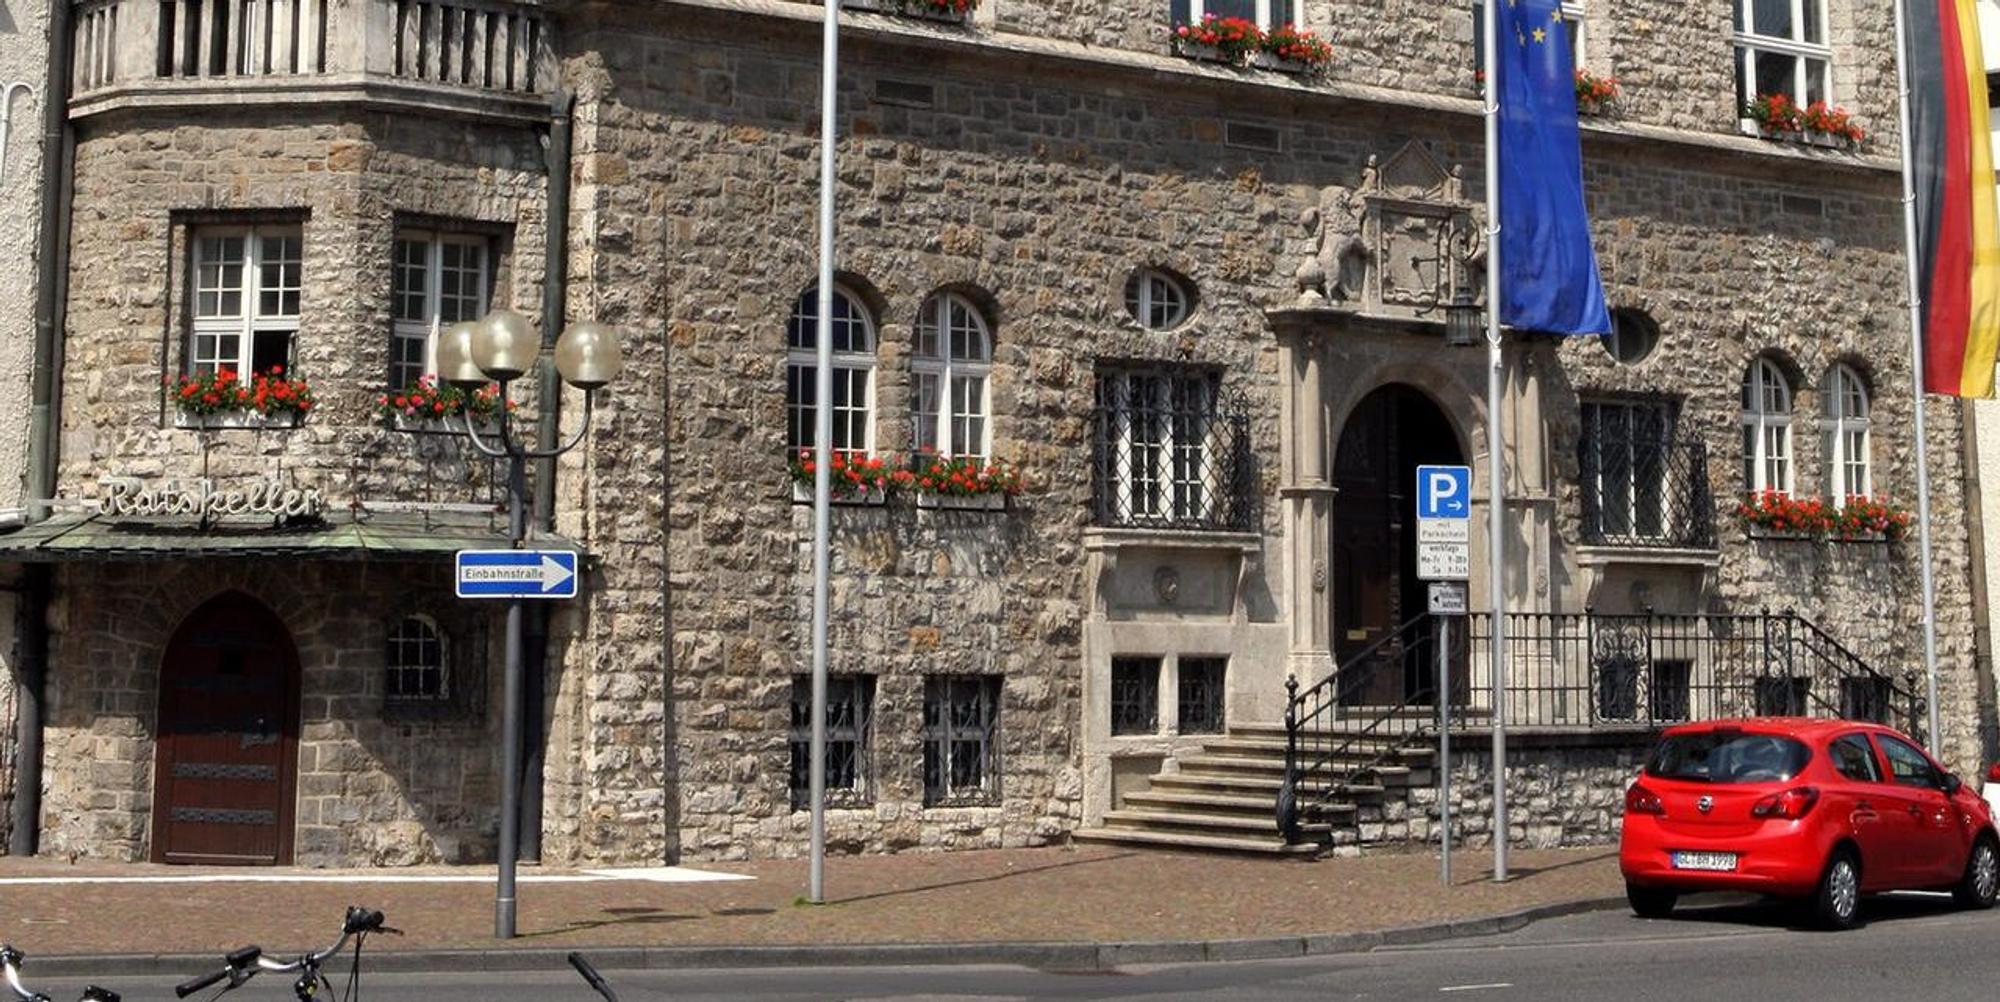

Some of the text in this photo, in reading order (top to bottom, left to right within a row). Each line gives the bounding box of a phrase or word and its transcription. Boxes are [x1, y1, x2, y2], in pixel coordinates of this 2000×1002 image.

[98, 477, 322, 516] Ratskeller
[1430, 473, 1458, 513] P
[465, 568, 545, 580] Einbahnstraße
